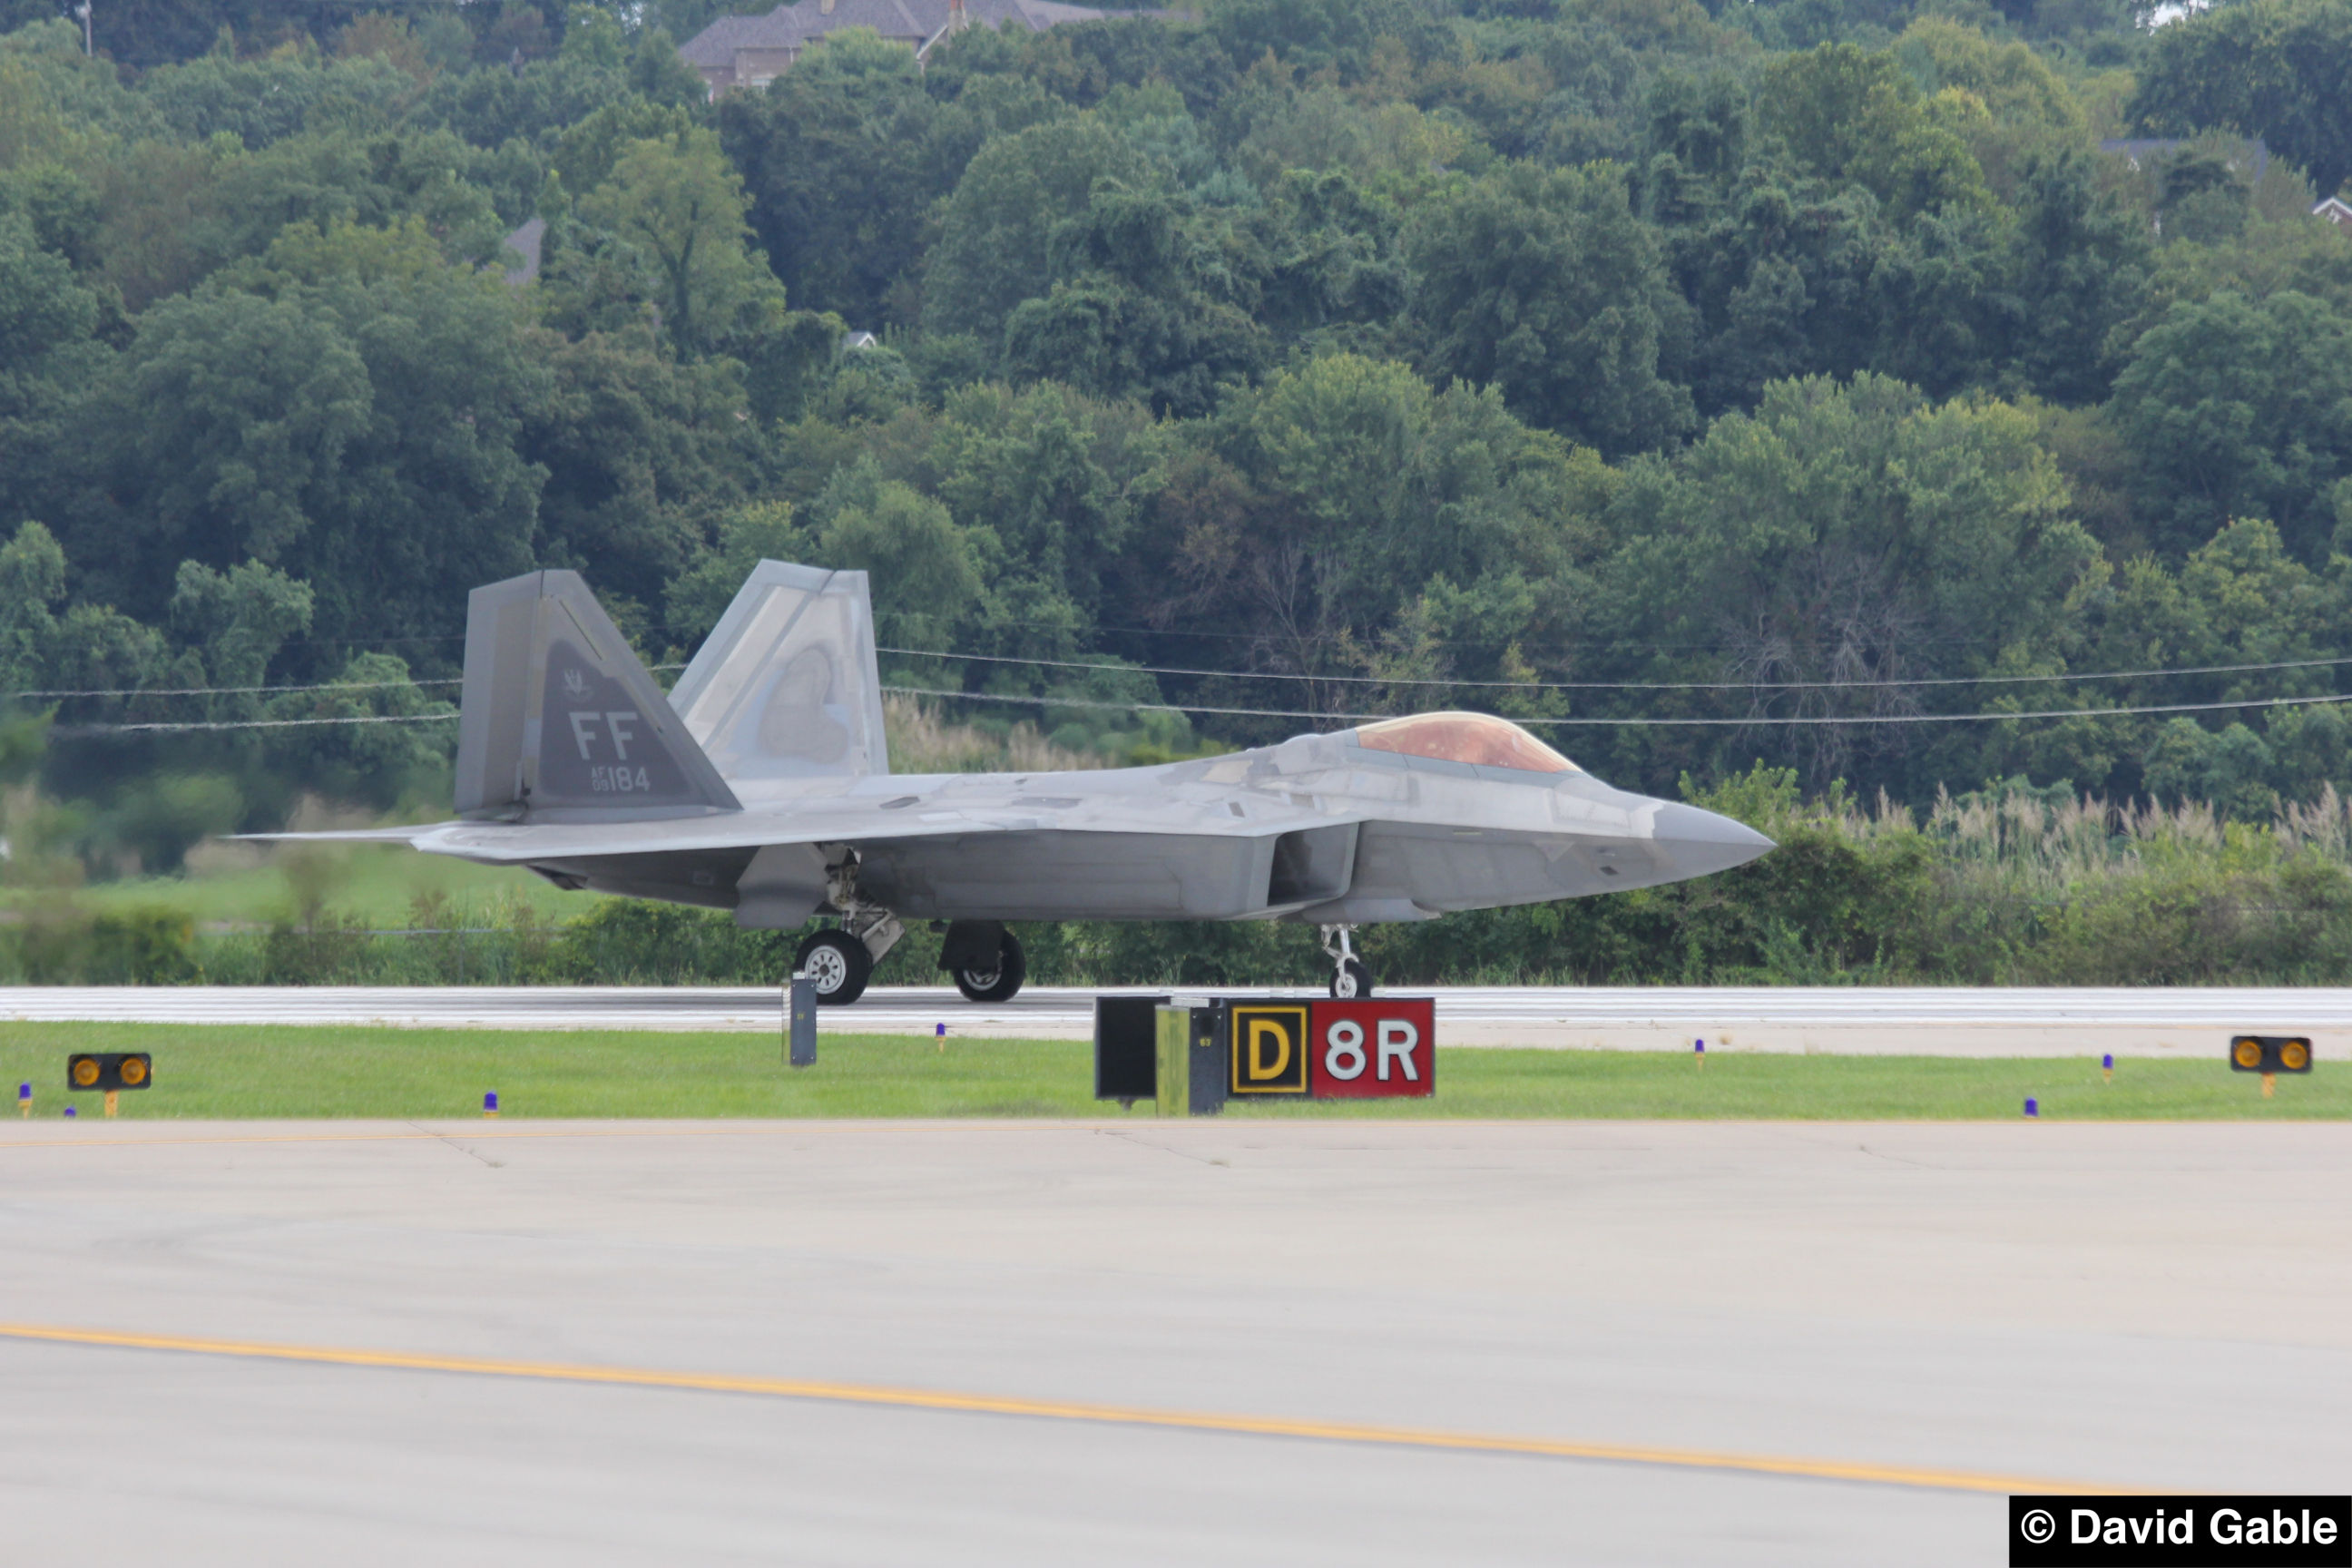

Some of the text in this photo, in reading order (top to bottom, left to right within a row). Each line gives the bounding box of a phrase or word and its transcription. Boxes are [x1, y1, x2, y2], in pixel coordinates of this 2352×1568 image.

[568, 711, 638, 760] FF
[592, 766, 606, 779] AF
[608, 766, 651, 791] 184
[1249, 1019, 1419, 1081] D 8R
